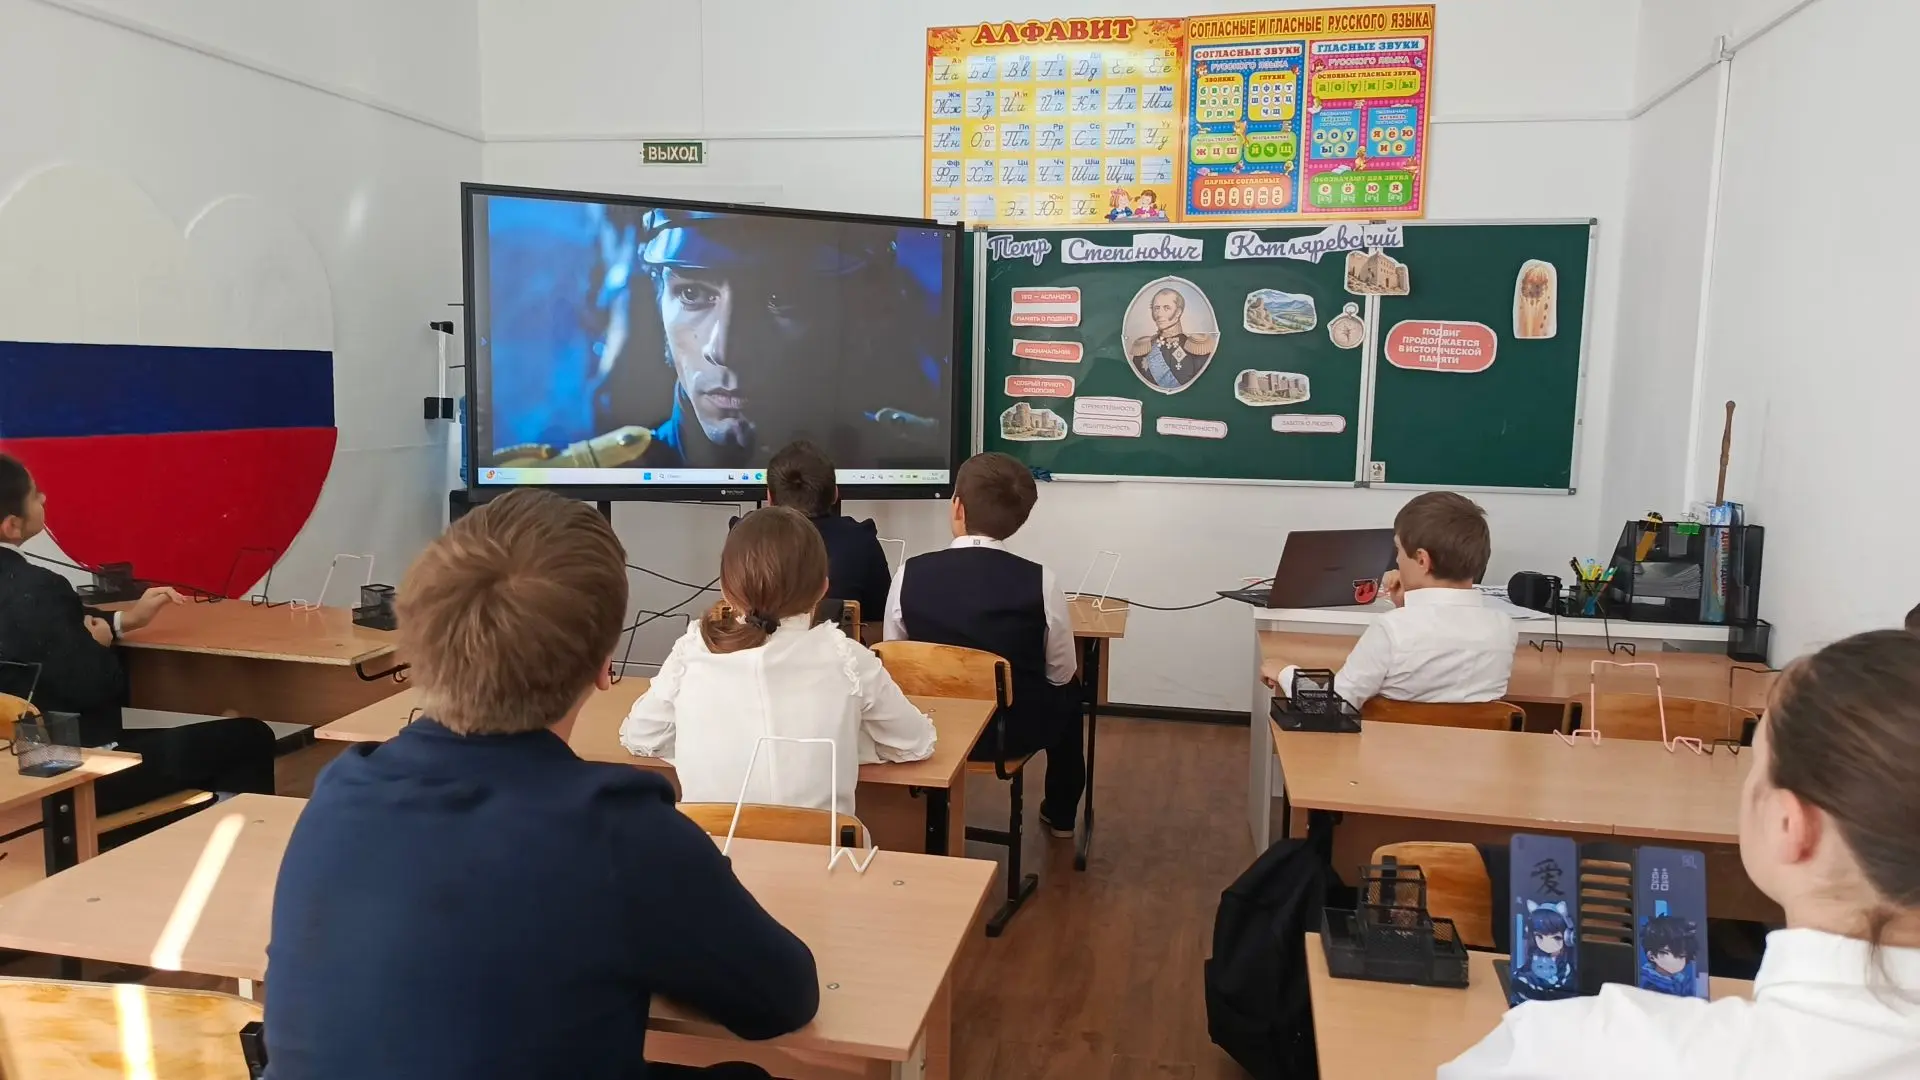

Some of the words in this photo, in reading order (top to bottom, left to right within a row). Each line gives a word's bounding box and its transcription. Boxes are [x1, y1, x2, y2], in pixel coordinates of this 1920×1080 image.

[1191, 20, 1255, 37] СОГЛАСНЫЕ
[1260, 19, 1265, 34] И
[1270, 16, 1321, 33] ГЛАСНЫЕ
[1328, 14, 1385, 30] РУССКОГО
[1391, 12, 1429, 28] ЯЗЫКА
[974, 19, 1133, 43] АЛФАВИТ
[1317, 42, 1375, 52] ГЛАСНЫЕ
[1379, 41, 1419, 49] ЗВУКИ
[1195, 48, 1261, 58] СОГЛАСНЫЕ
[1264, 47, 1300, 55] ЗВУКИ
[1346, 131, 1353, 139] у
[1389, 128, 1395, 138] ё
[649, 147, 698, 161] ВЫХОД
[989, 237, 1049, 263] Петр
[1069, 235, 1200, 260] Степанович
[1423, 328, 1461, 336] ПОДВИГ
[1403, 337, 1480, 346] ПРОДОЛЖАЕТСЯ
[1406, 345, 1481, 356] ИСТОРИЧЕСКОЙ
[1419, 355, 1459, 364] ПАМЯТИ
[1531, 858, 1564, 896] 爱
